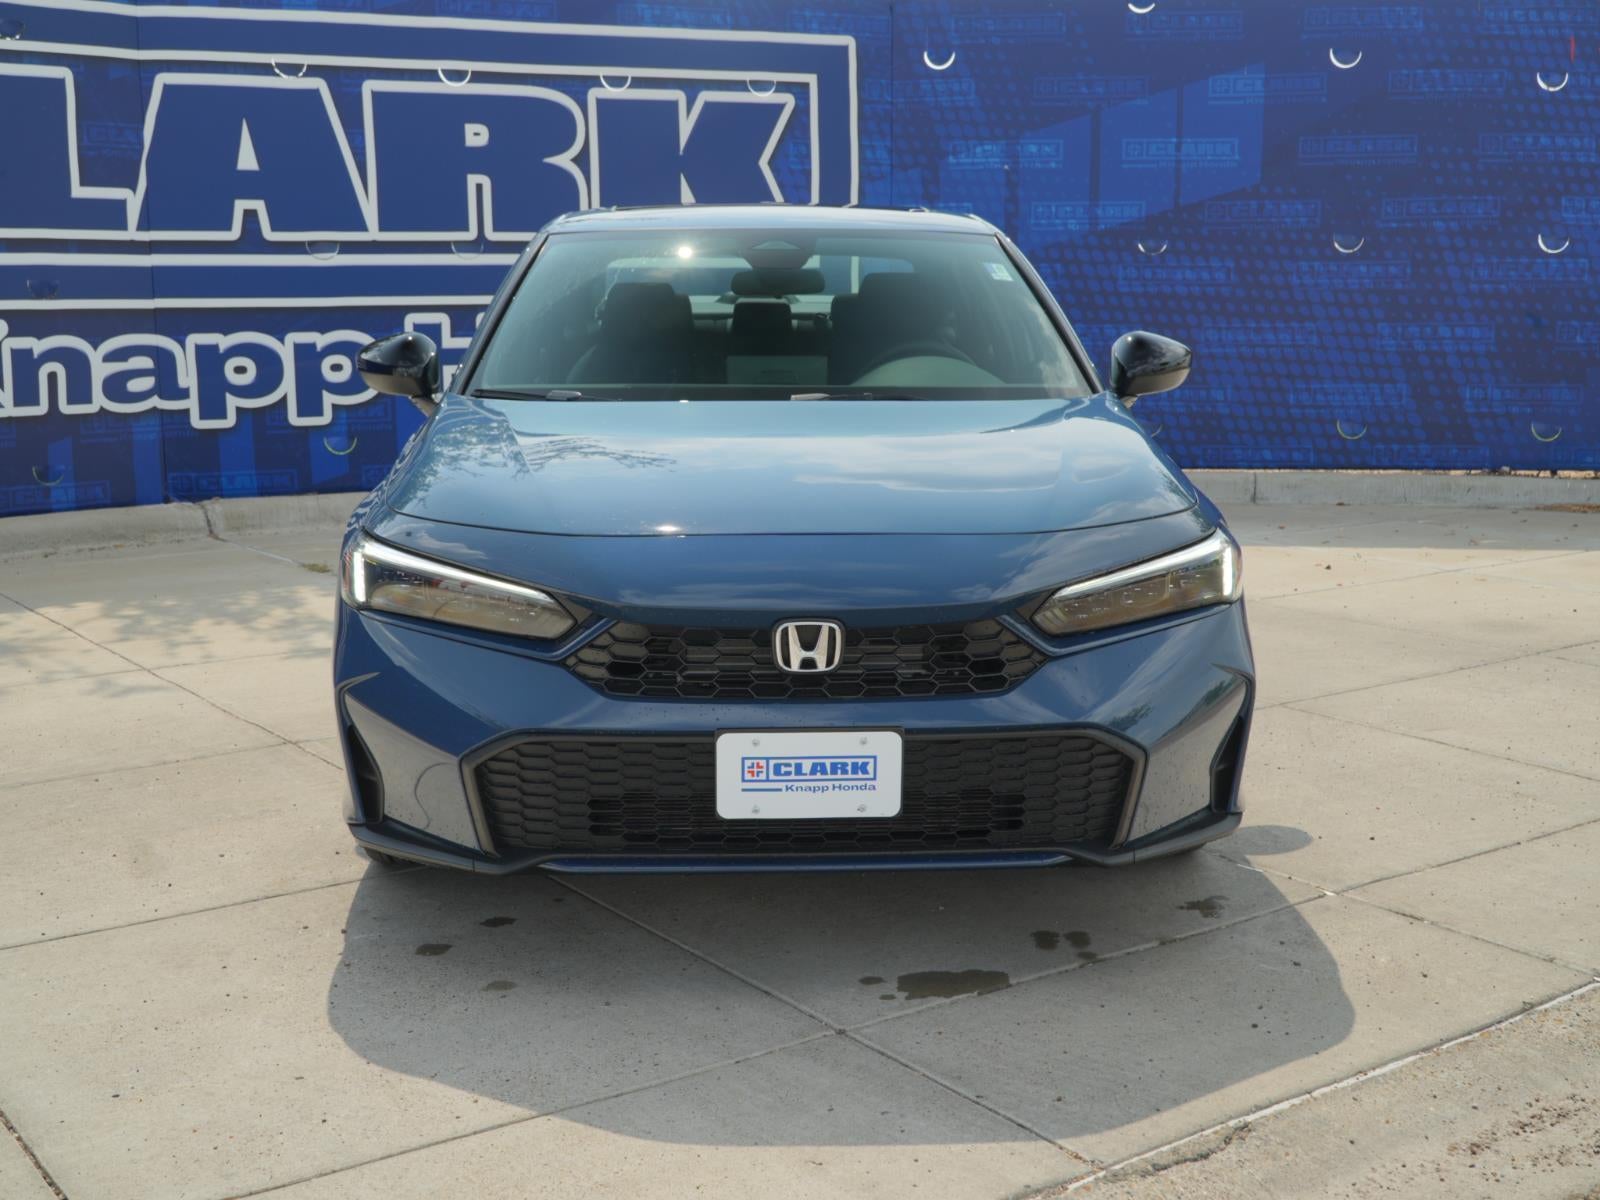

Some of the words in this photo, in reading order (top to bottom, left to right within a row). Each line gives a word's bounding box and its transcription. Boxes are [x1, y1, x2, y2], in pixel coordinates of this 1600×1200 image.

[0, 318, 378, 429] napp
[773, 761, 870, 777] CLARK
[785, 784, 830, 794] Knapp
[832, 783, 877, 792] Honda
